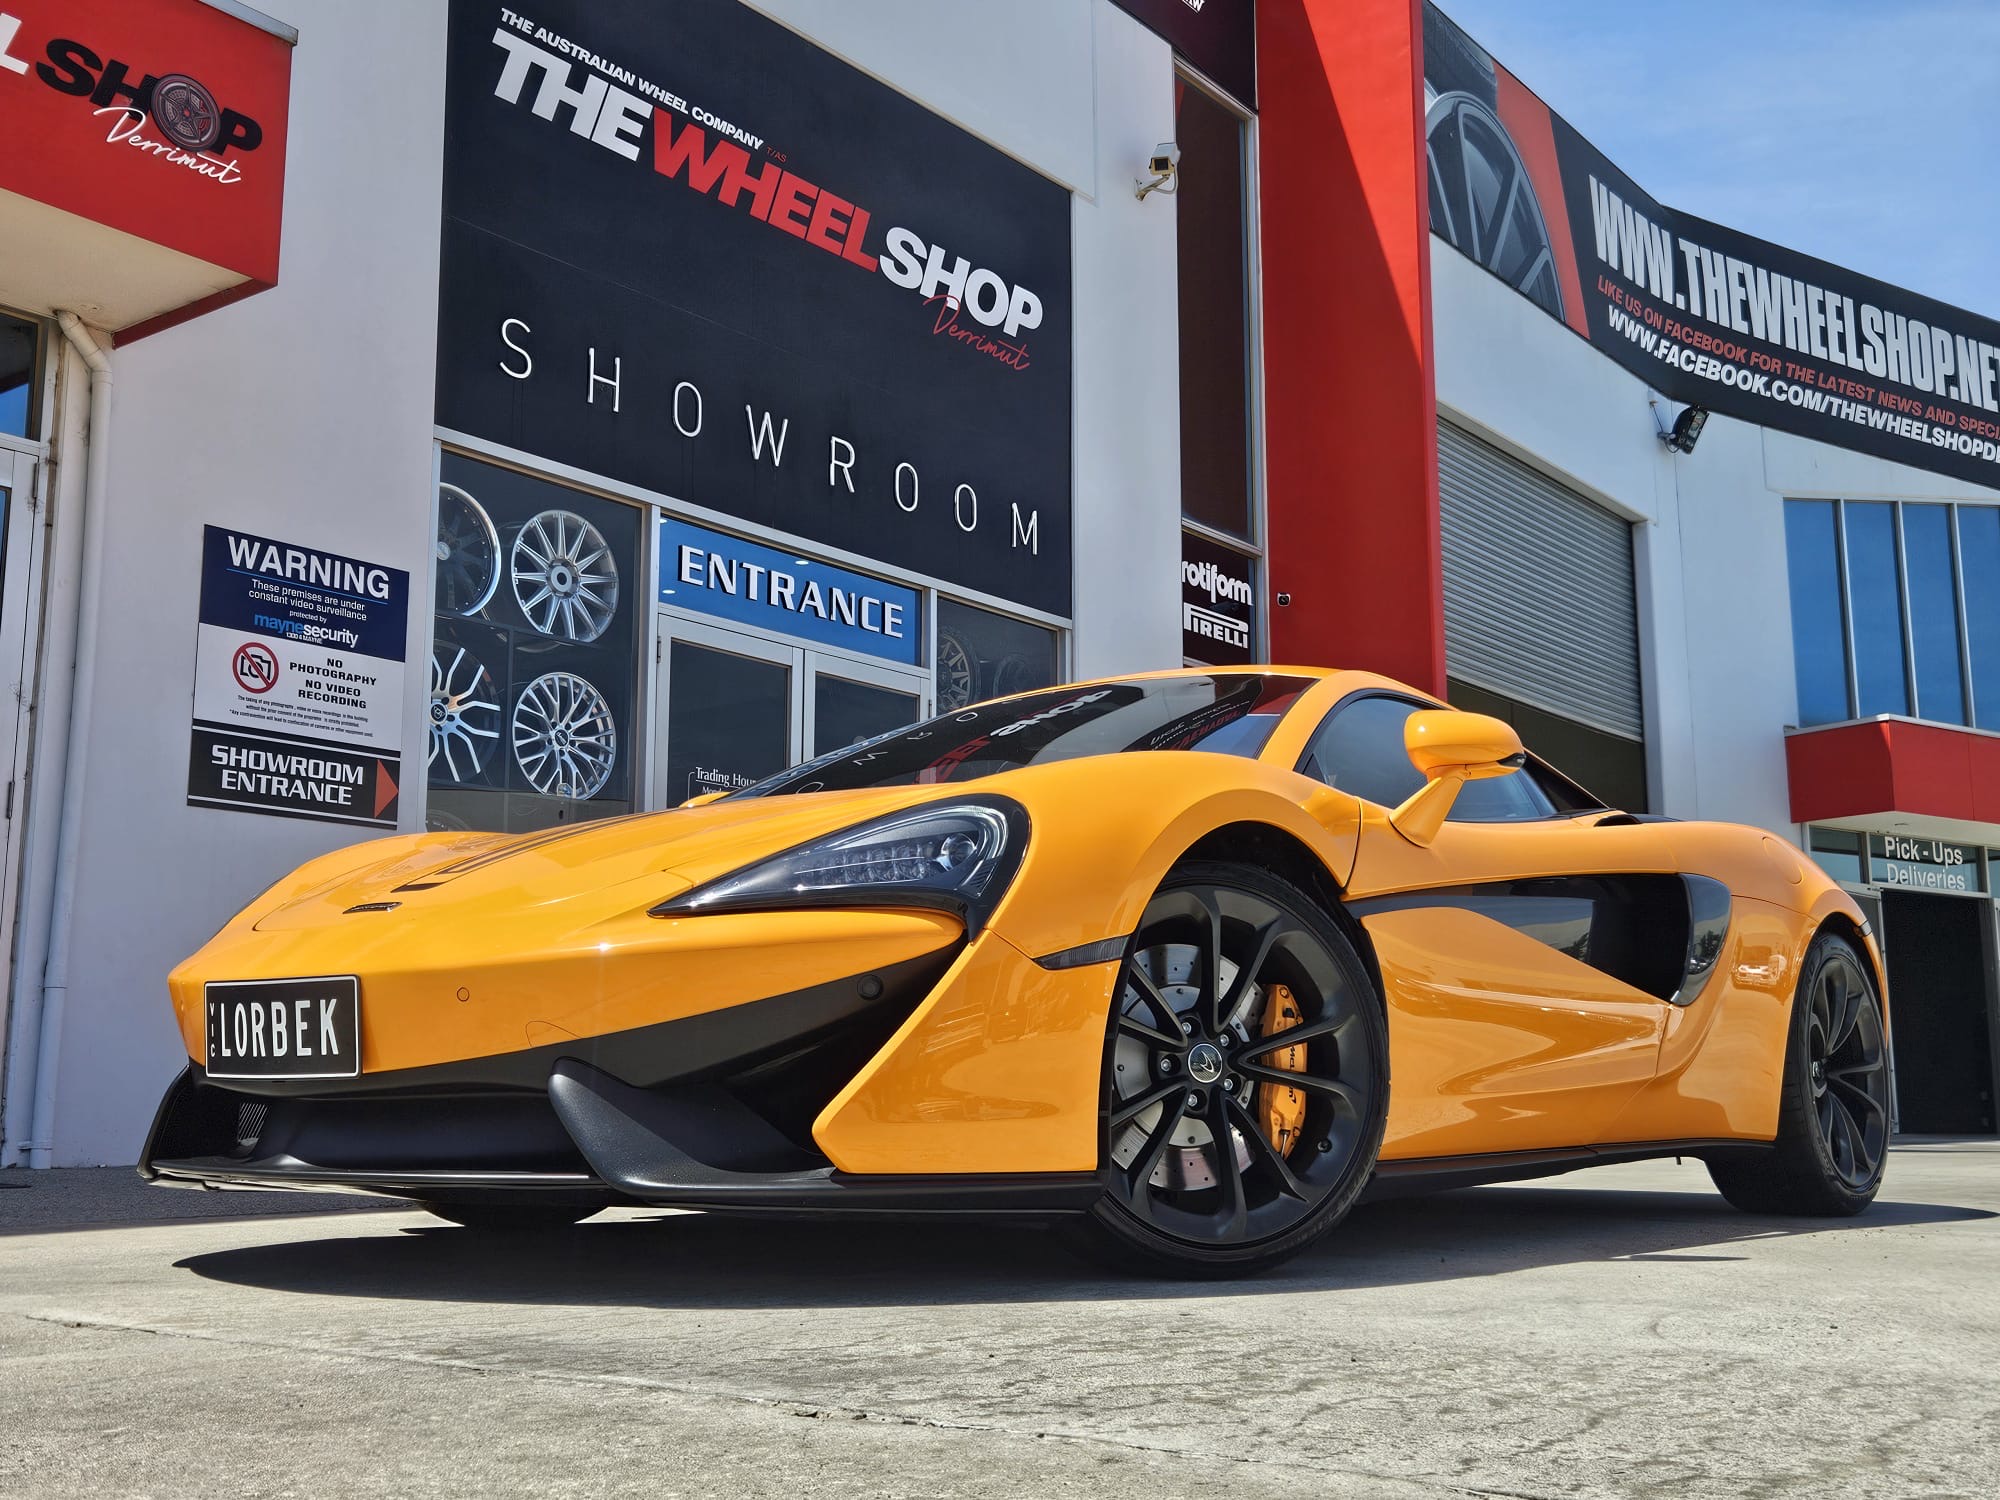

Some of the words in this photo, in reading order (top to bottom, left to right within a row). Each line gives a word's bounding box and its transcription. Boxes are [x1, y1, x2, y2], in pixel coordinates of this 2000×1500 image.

[501, 7, 535, 35] THE
[535, 26, 636, 86] AUSTRALIAN
[638, 77, 689, 115] WHEEL
[692, 106, 764, 150] COMPANY
[93, 106, 241, 184] Derrimut
[492, 27, 653, 162] THE
[653, 106, 879, 272] WHEEL
[879, 226, 1043, 338] SHOP
[1589, 174, 2000, 412] WWW.THEWHEELSHOP.NE
[922, 294, 1031, 371] Derrimut
[1597, 274, 1623, 305] LIKE
[1625, 294, 1642, 318] US
[1643, 307, 1663, 331] ON
[1664, 318, 1748, 364] FACEBOOK
[1749, 351, 1782, 375] FOR
[1786, 361, 1815, 386] THE
[1817, 371, 1876, 402] LATEST
[1877, 391, 1923, 417] NEWS
[1924, 405, 1956, 426] AND
[1959, 415, 2000, 440] SPECI
[499, 318, 1039, 556] SHOWROOM
[227, 535, 389, 600] WARNING
[1181, 560, 1252, 606] rotiform
[248, 590, 288, 605] constant
[290, 596, 314, 610] video
[316, 603, 367, 621] surveillance
[252, 579, 280, 593] These
[282, 587, 322, 602] premises
[325, 596, 338, 606] are
[340, 598, 365, 611] under
[679, 544, 904, 640] ENTRANCE
[289, 610, 319, 621] protected
[319, 615, 327, 624] by
[1183, 602, 1249, 649] PIRELLI
[289, 662, 377, 686] PHOTOGRAPHY
[327, 658, 343, 669] NO
[298, 689, 367, 709] RECORDING
[305, 679, 322, 690] NO
[326, 684, 361, 697] VIDEO
[211, 744, 364, 785] SHOWROOM
[696, 766, 730, 787] Trading
[221, 769, 353, 806] ENTRANCE
[1884, 836, 1920, 861] Pick
[1931, 841, 1963, 869] Ups
[1887, 863, 1966, 890] Deliveries
[220, 998, 339, 1058] LORBEK
